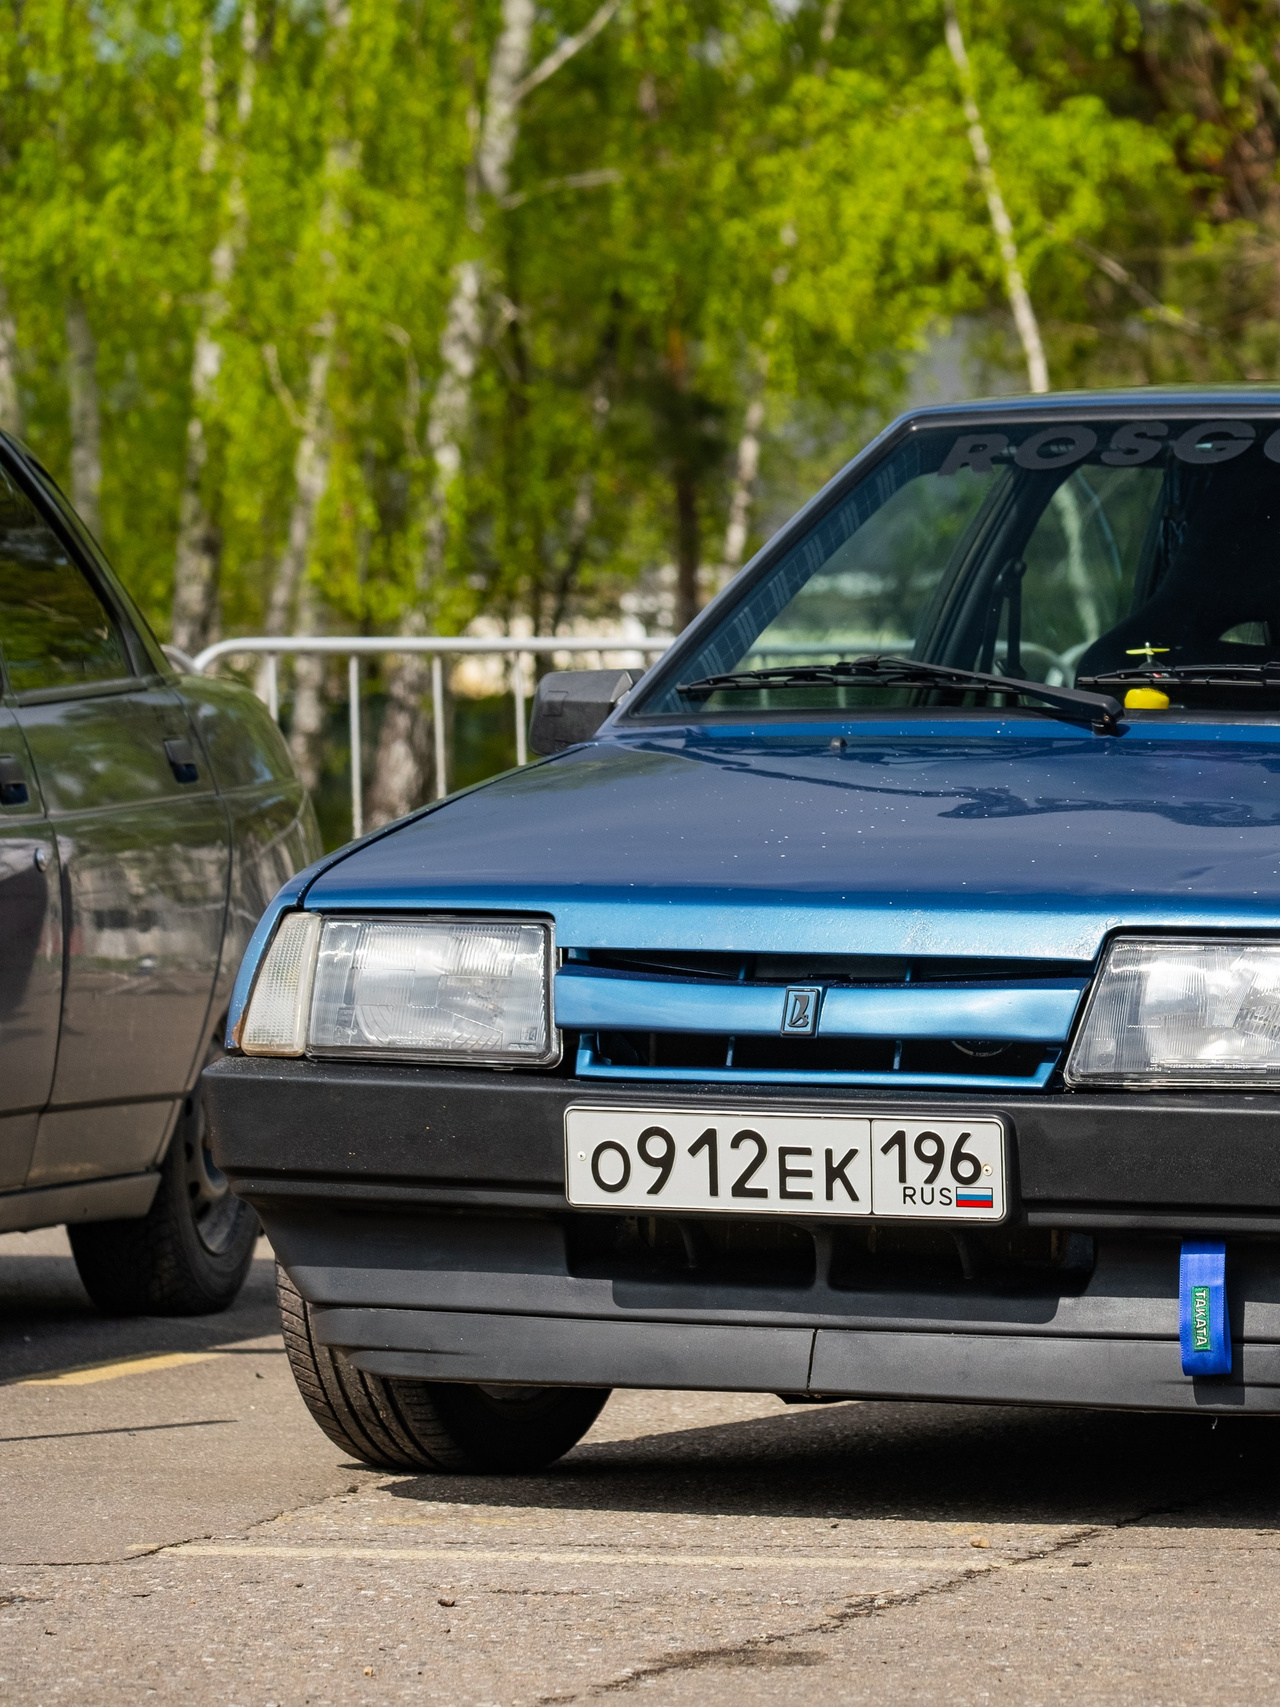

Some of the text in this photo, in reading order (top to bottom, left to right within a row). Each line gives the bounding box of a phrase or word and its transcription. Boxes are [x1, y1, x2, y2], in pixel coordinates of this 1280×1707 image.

[881, 1129, 982, 1185] 196
[902, 1186, 953, 1206] RUS
[1195, 1289, 1208, 1346] TAKATA
